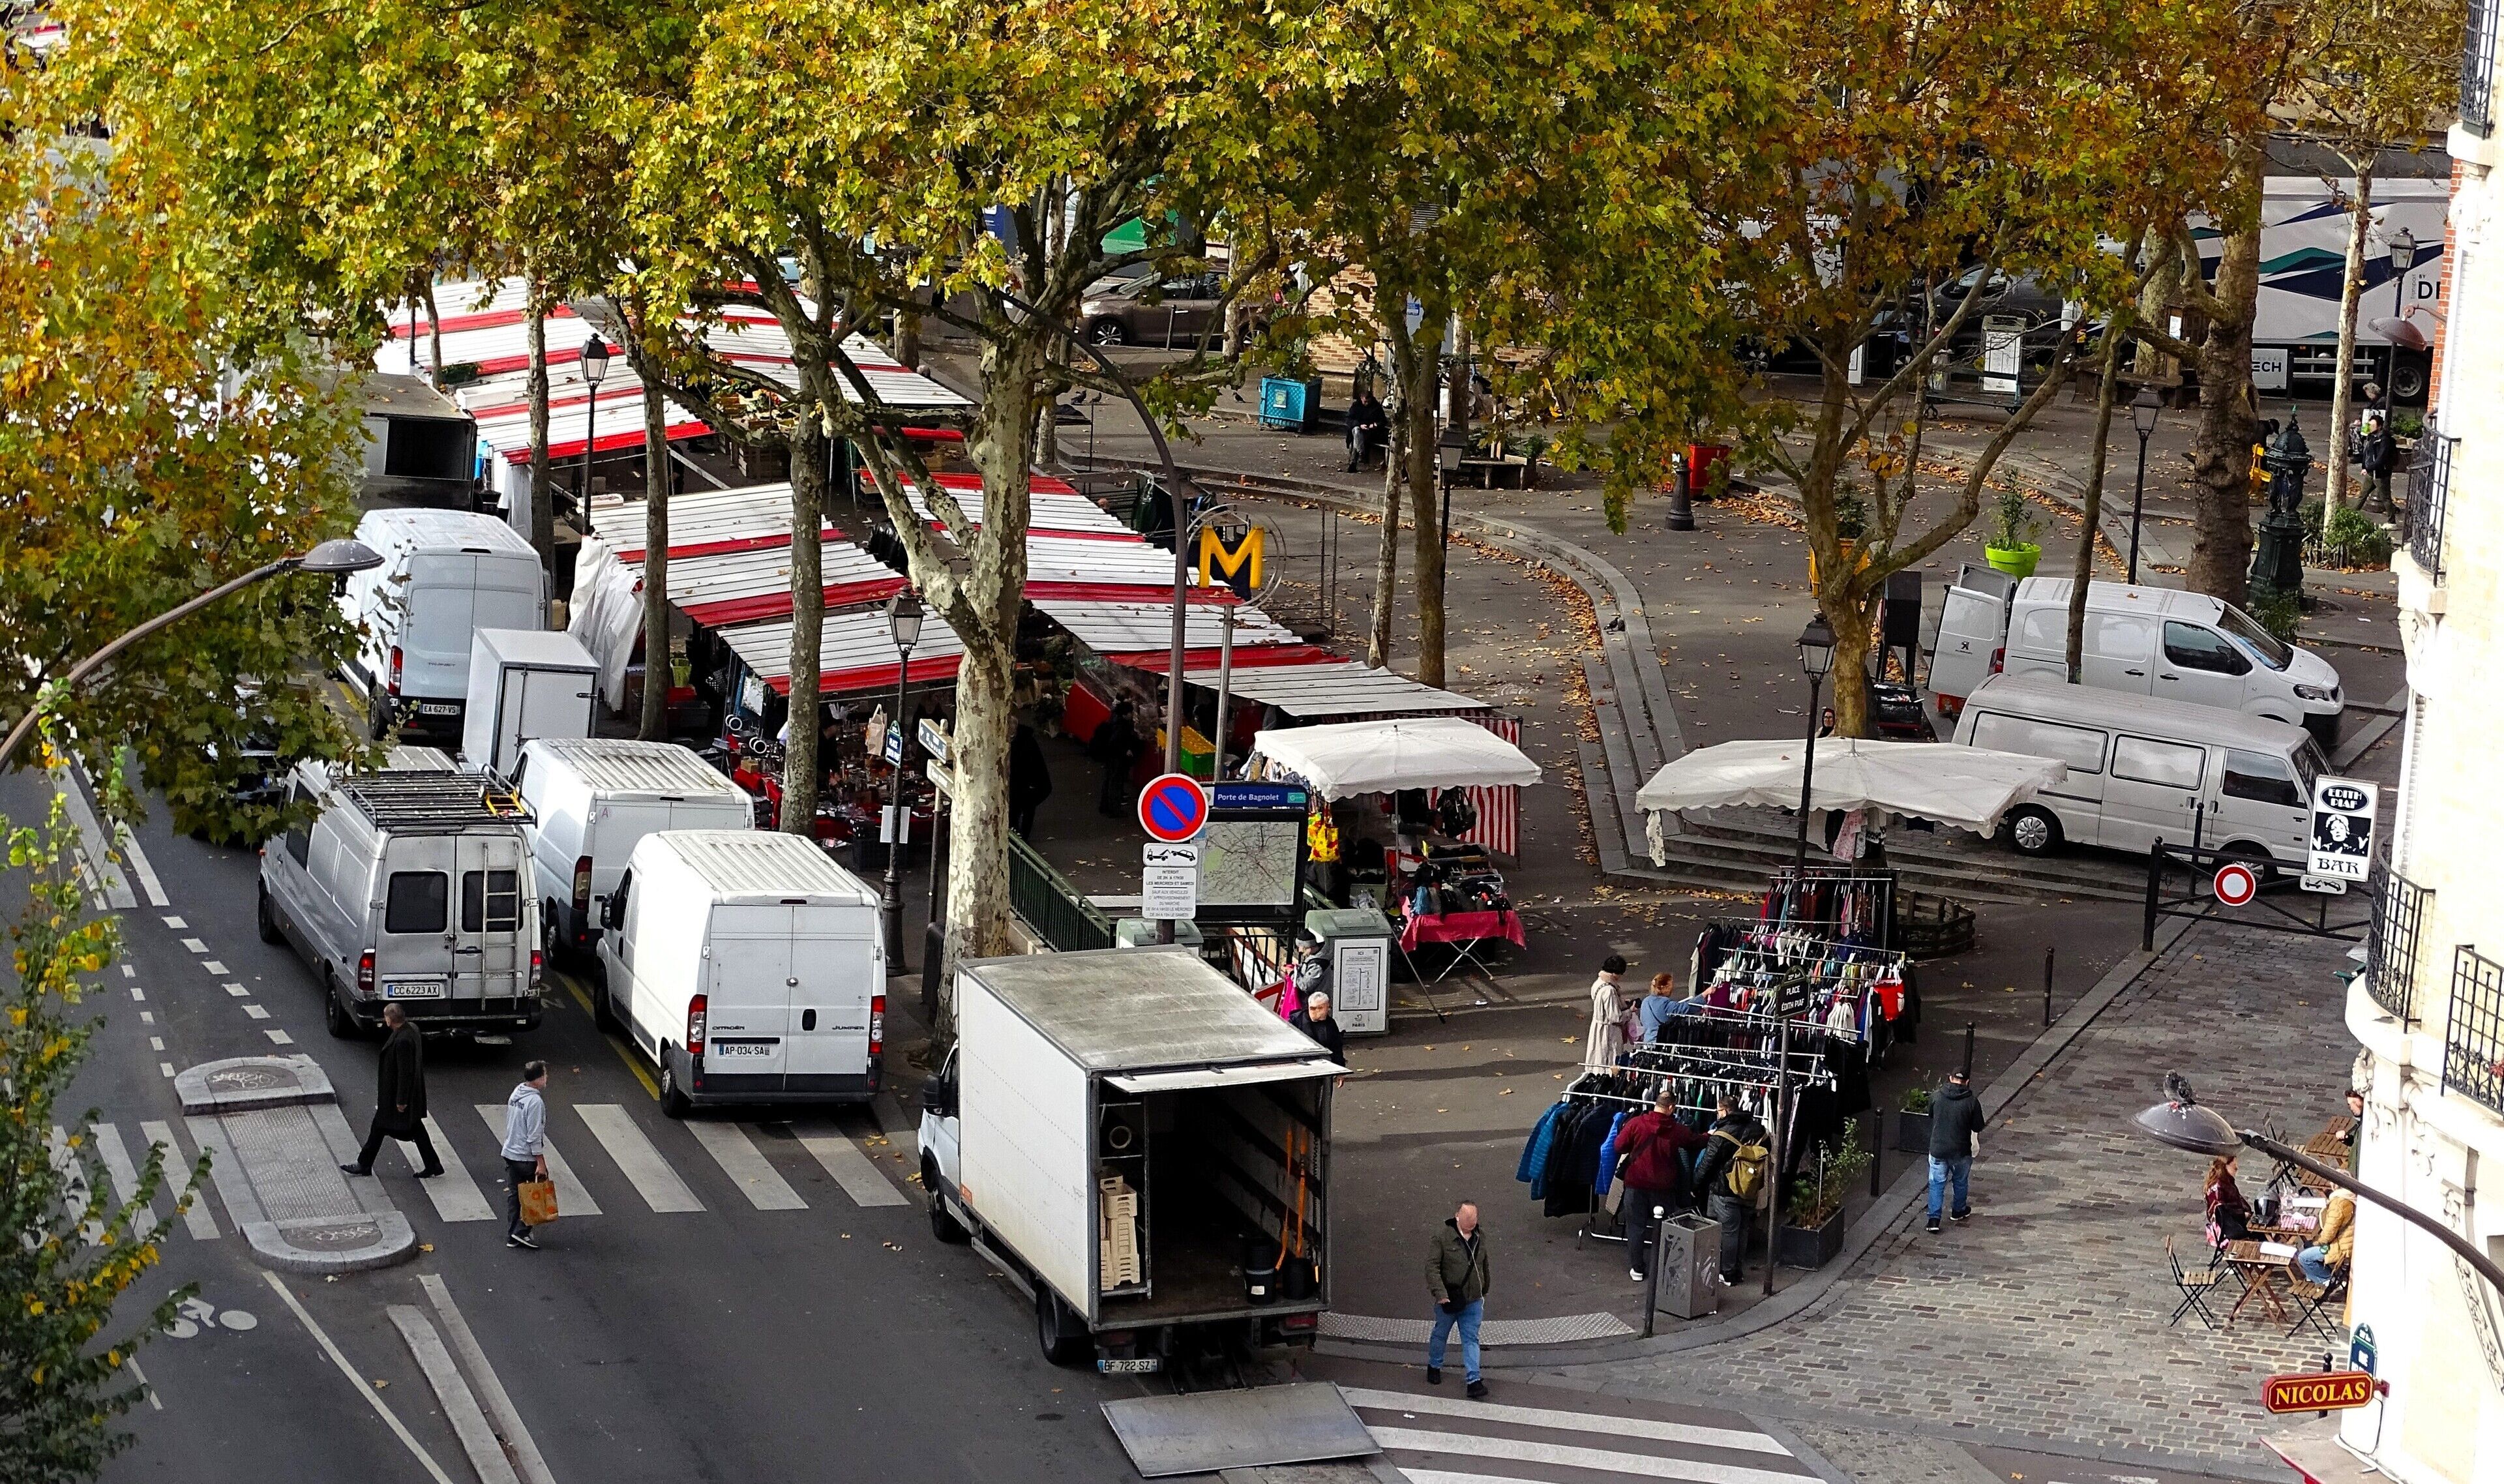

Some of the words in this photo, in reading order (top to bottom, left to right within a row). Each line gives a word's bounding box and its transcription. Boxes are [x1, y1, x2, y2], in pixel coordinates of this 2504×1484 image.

[1198, 525, 1264, 589] M
[2328, 788, 2362, 801] EDITH
[2331, 798, 2358, 809] PIAF
[2317, 858, 2360, 874] BAR
[1787, 985, 1800, 996] PLACE
[1795, 998, 1805, 1007] PIAF
[2275, 1382, 2366, 1405] NICOLAS
